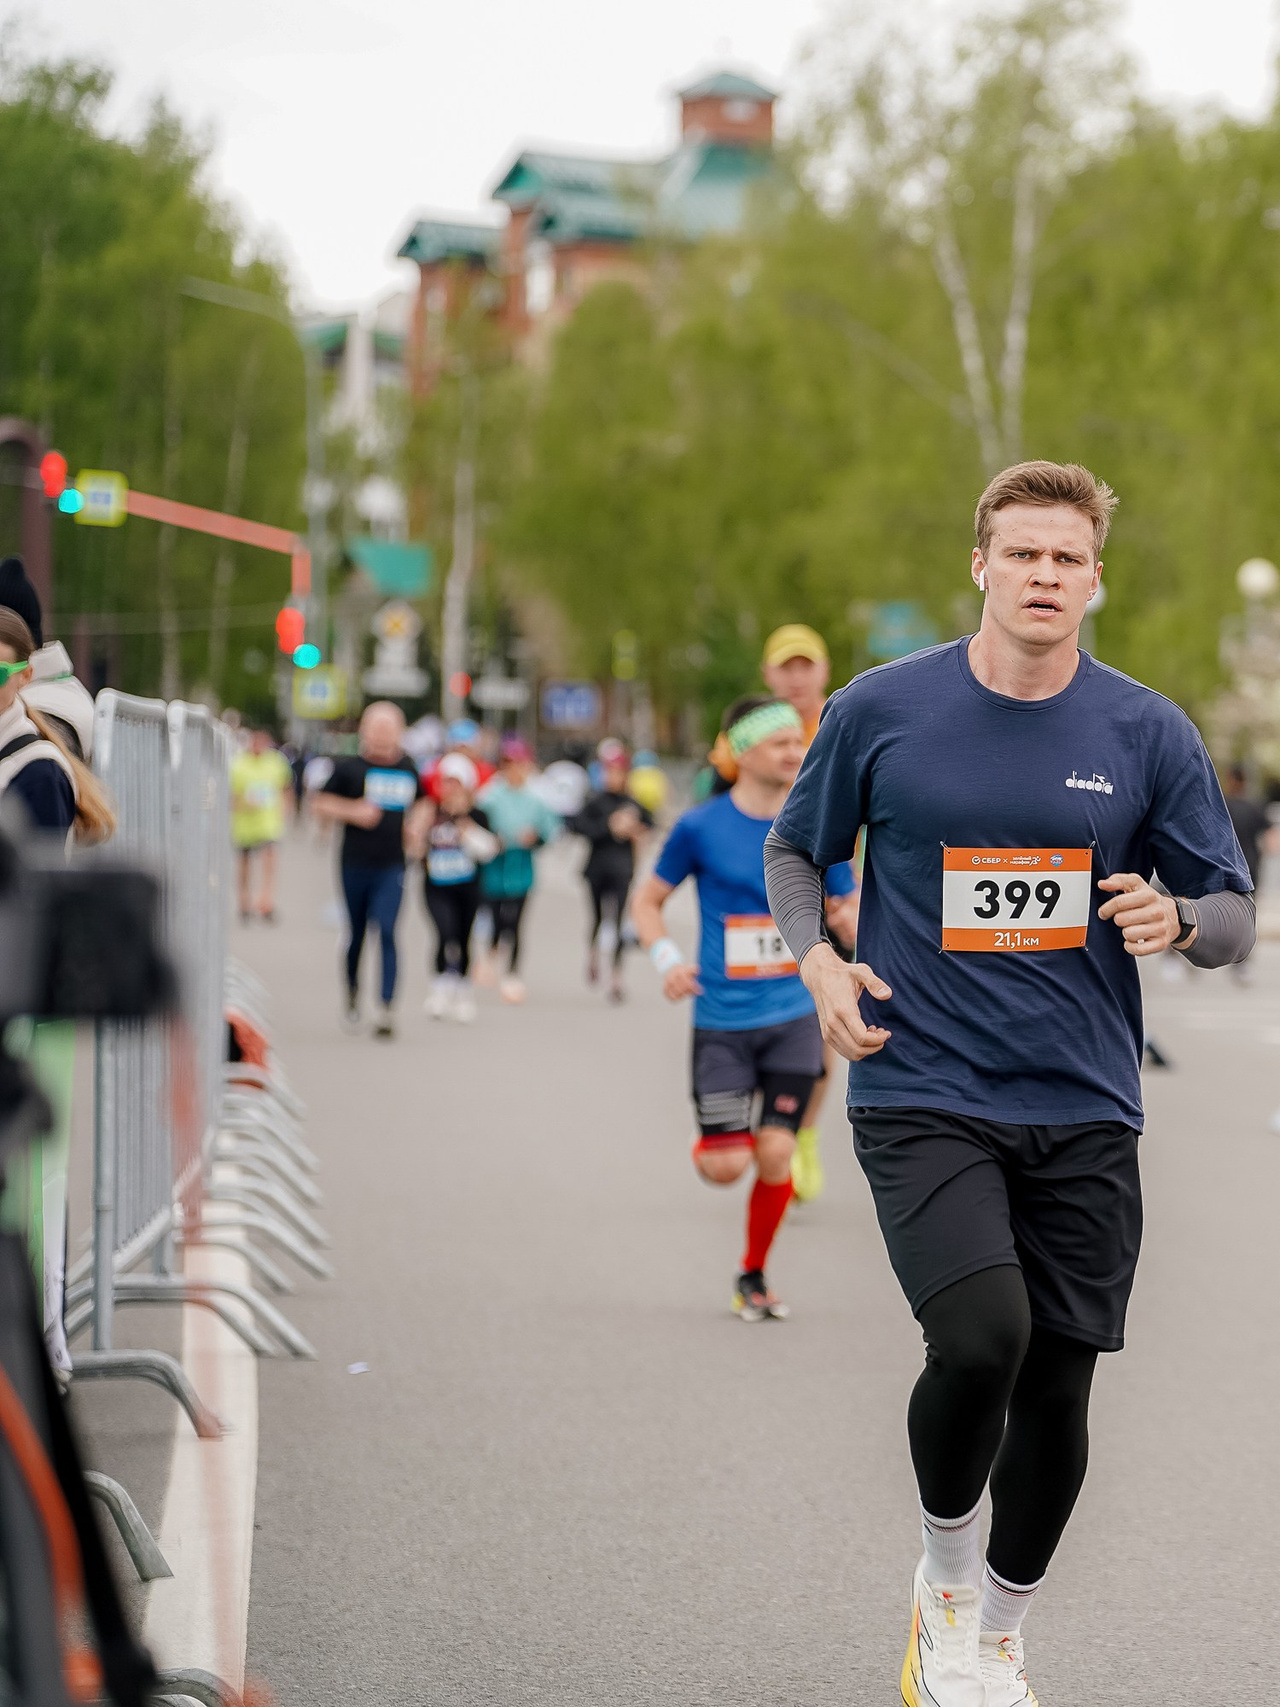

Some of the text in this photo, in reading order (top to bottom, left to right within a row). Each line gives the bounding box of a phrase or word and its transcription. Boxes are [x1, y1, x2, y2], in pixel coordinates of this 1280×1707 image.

[981, 857, 1001, 865] СБЕР
[973, 879, 1061, 919] 399
[994, 932, 1021, 949] 21,1
